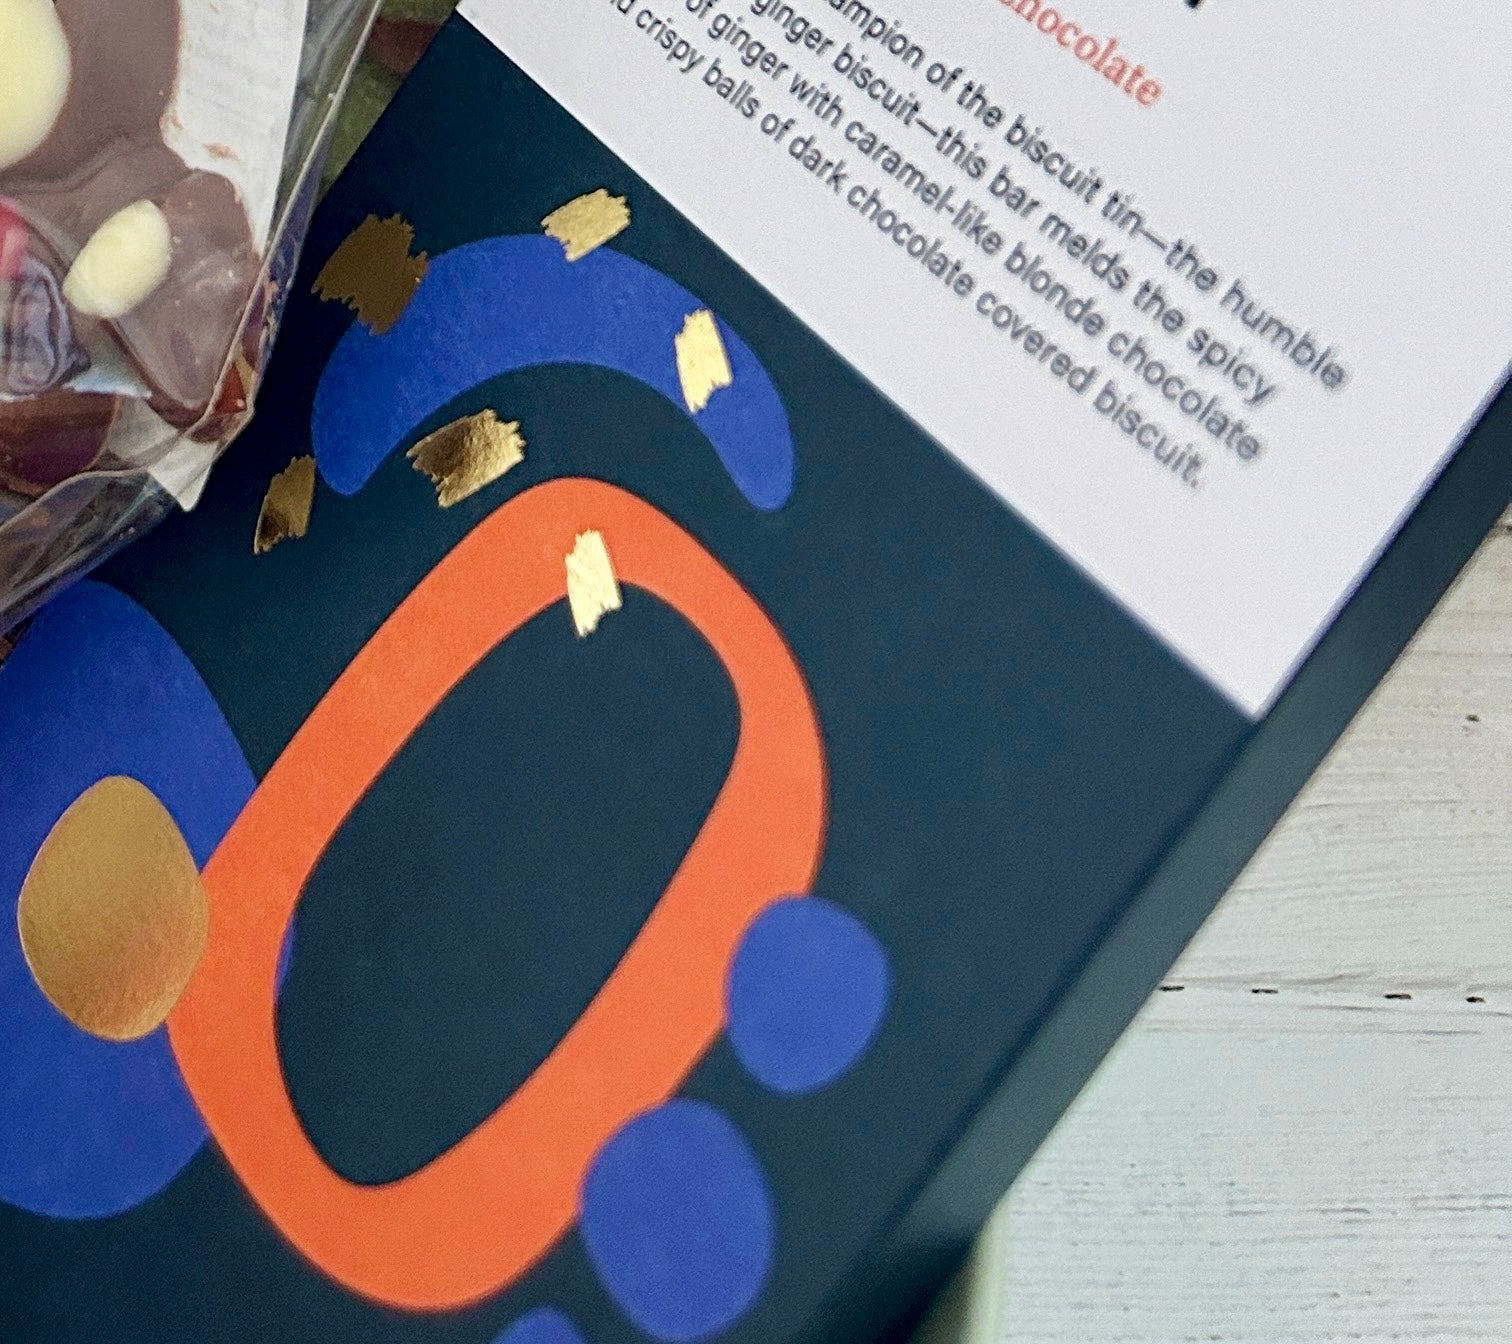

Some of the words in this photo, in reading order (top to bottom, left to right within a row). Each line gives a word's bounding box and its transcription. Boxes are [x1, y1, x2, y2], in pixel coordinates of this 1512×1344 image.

[635, 8, 704, 75] crispy
[702, 58, 761, 119] balls
[759, 112, 796, 144] of
[788, 134, 849, 194] dark
[846, 184, 975, 297] chocolate
[976, 290, 1099, 395] covered
[1093, 379, 1208, 489] biscuit.
[707, 11, 789, 82] ginger
[789, 73, 844, 128] with
[844, 120, 1004, 255] caramel-like
[1004, 241, 1106, 338] blonde
[1107, 331, 1262, 463] chocolate
[925, 61, 963, 93] of
[957, 80, 1003, 128] the
[1005, 114, 1104, 205] biscuit
[1220, 279, 1348, 391] humble
[989, 165, 1041, 218] bar
[1039, 212, 1130, 292] melds
[1132, 279, 1185, 334] the
[1188, 327, 1277, 407] spicy
